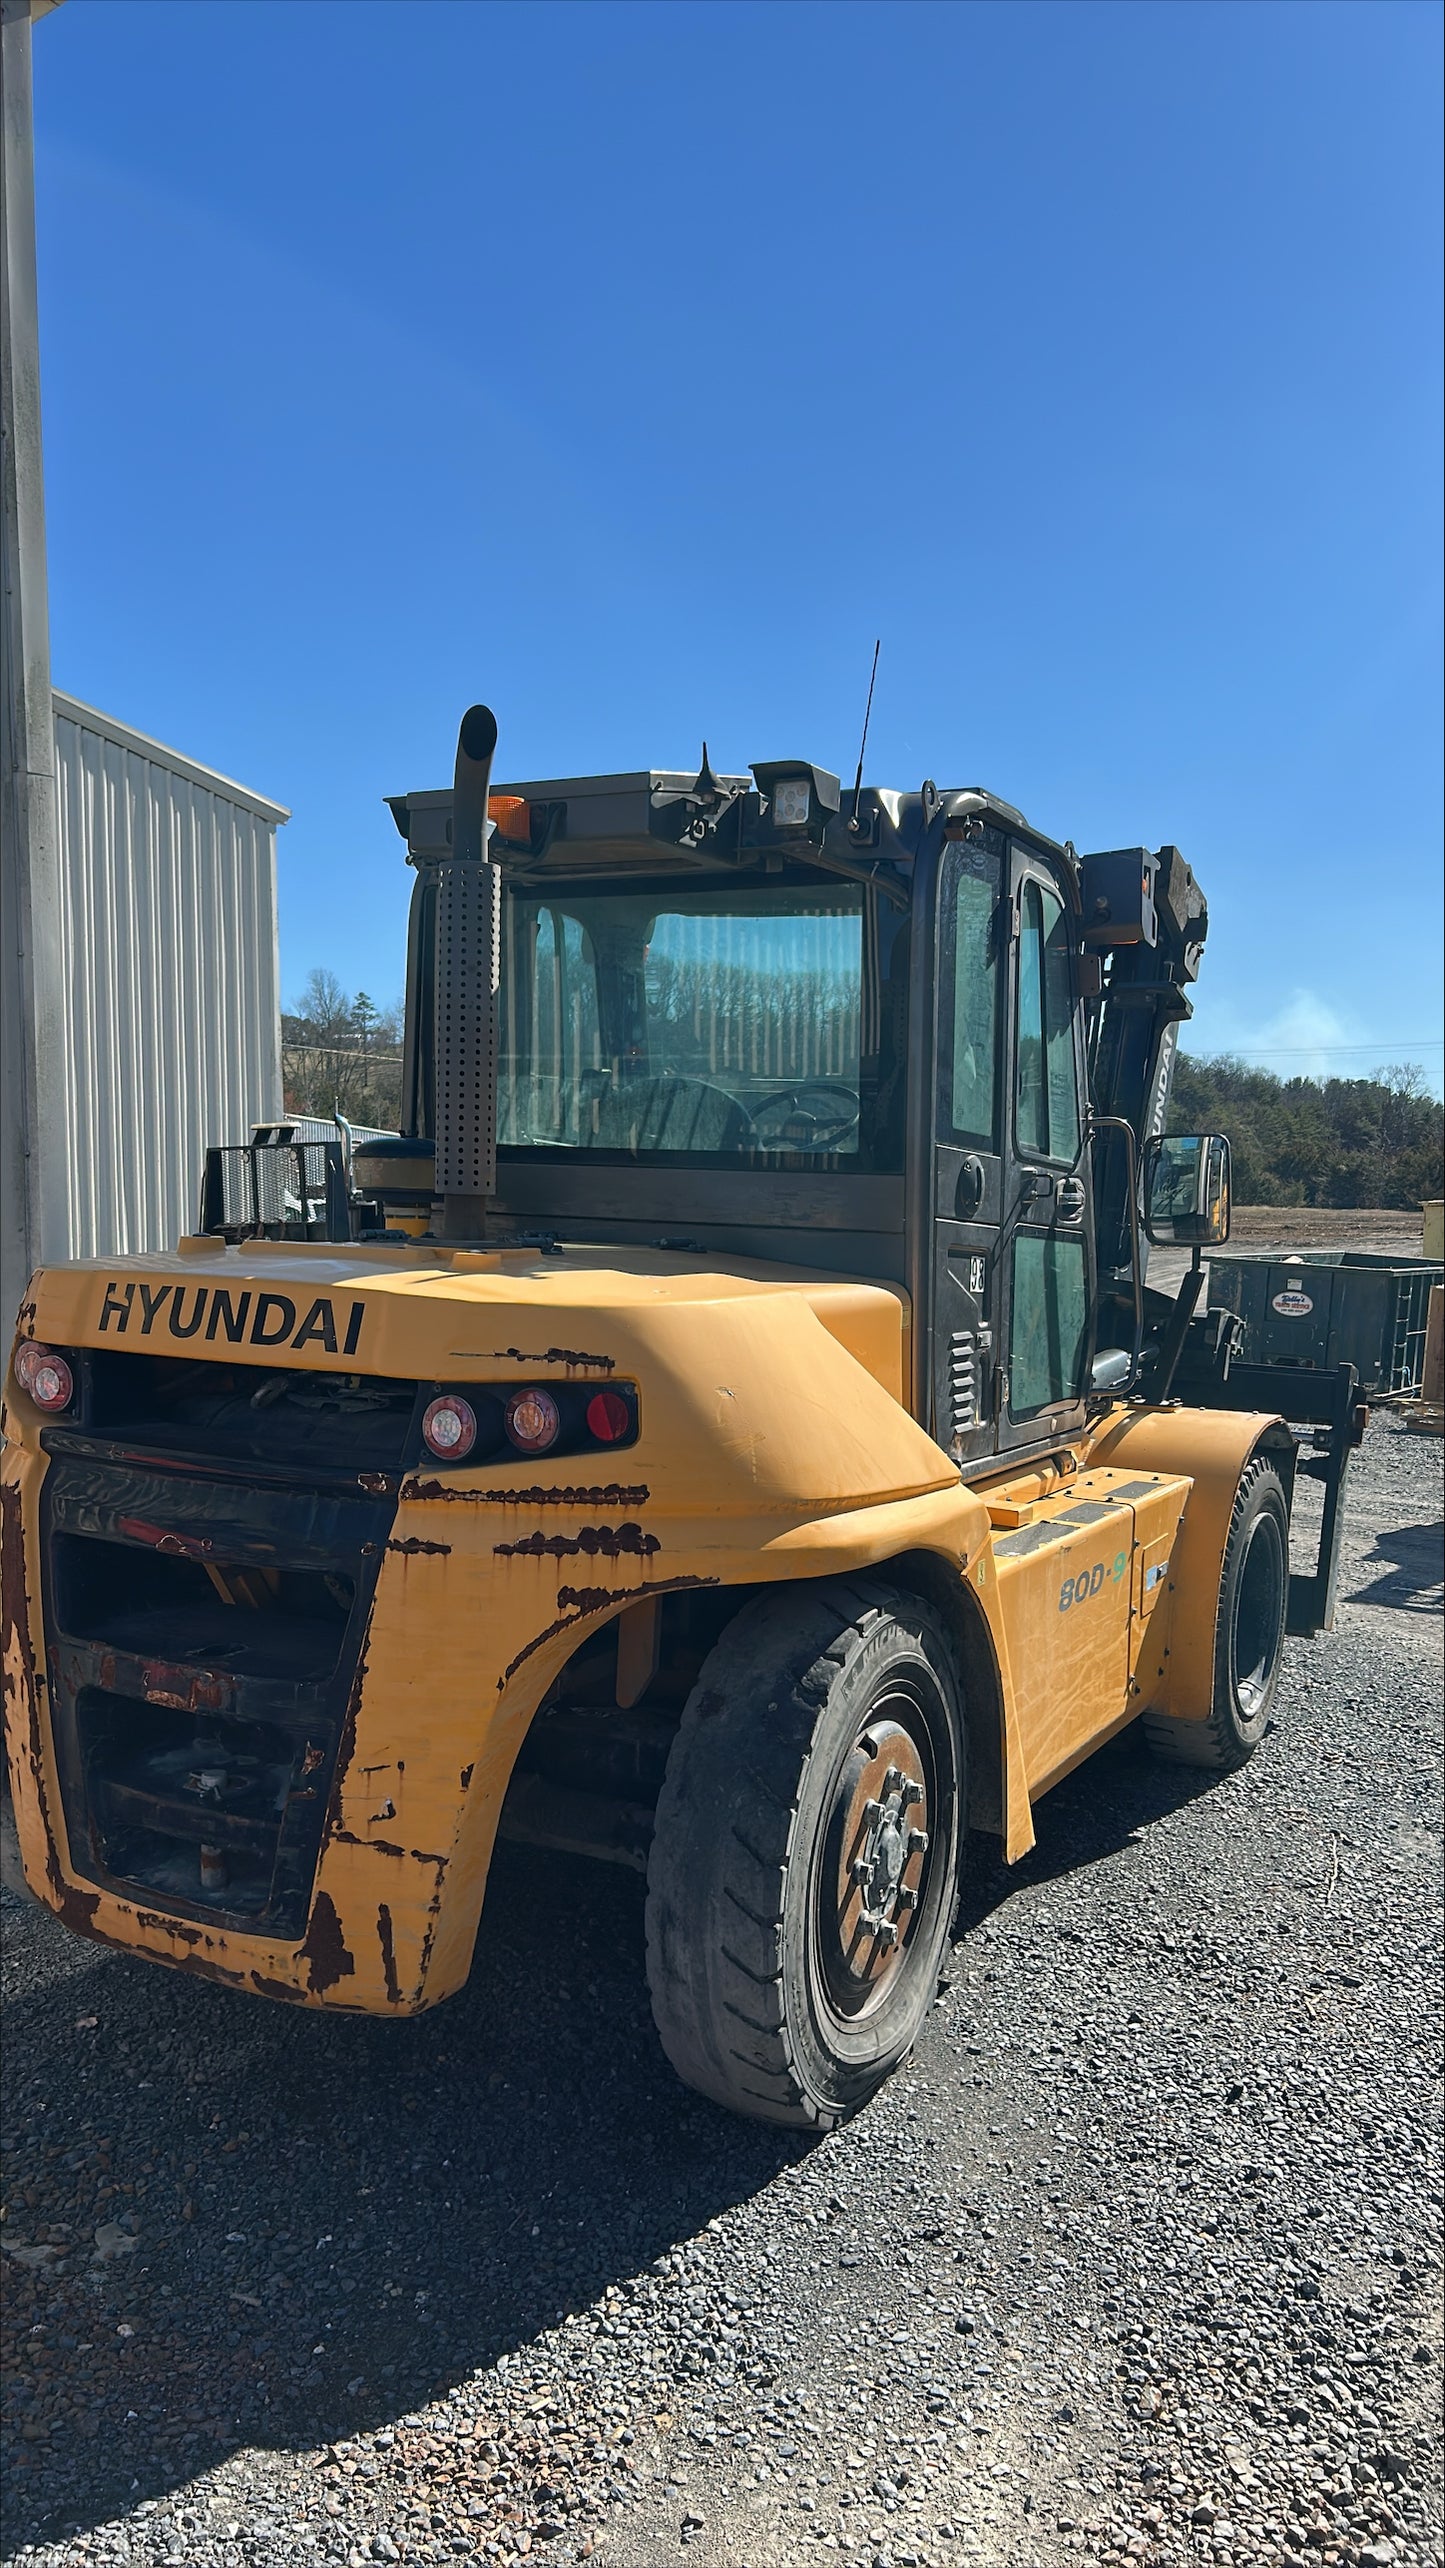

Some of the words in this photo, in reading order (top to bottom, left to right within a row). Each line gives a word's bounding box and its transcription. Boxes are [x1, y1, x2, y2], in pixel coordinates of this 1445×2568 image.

[1151, 1032, 1174, 1137] UNDAI
[971, 1257, 984, 1290] 98
[98, 1282, 366, 1355] HYUNDAI
[1058, 1551, 1127, 1612] 80D-9
